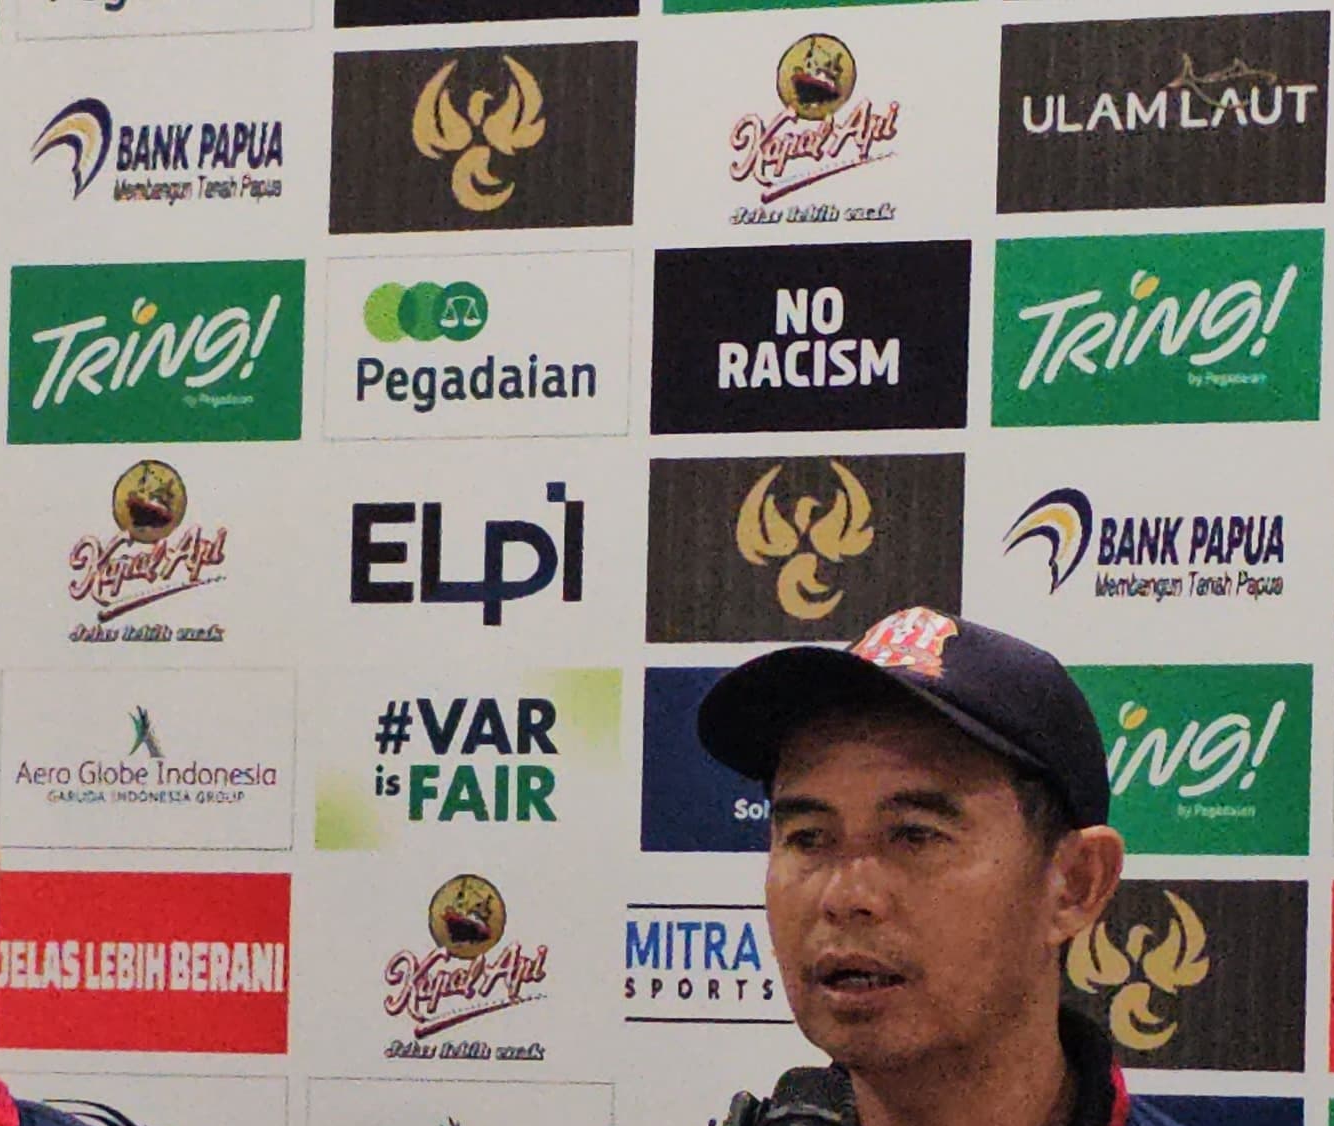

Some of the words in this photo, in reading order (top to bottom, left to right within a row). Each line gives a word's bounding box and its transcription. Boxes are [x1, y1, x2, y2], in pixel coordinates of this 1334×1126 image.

[1022, 90, 1166, 133] ULAM
[1179, 85, 1318, 128] LAUT
[117, 125, 186, 170] BANK
[198, 122, 283, 169] PAPUA
[776, 287, 843, 334] NO
[357, 354, 596, 413] Pegadaian
[718, 339, 899, 389] RACISM
[1098, 519, 1183, 566] BANK
[1189, 515, 1284, 565] PAPUA
[1237, 571, 1283, 600] Papua
[376, 697, 557, 755] #VAR
[15, 761, 72, 786] Aero
[78, 760, 148, 786] Globe
[157, 760, 275, 786] Indonesia
[376, 765, 401, 796] is
[409, 764, 557, 822] FAIR
[86, 943, 165, 990] LEBIH
[171, 942, 286, 993] BERANI
[625, 921, 761, 971] MITRA
[625, 978, 774, 1001] SPORTS
